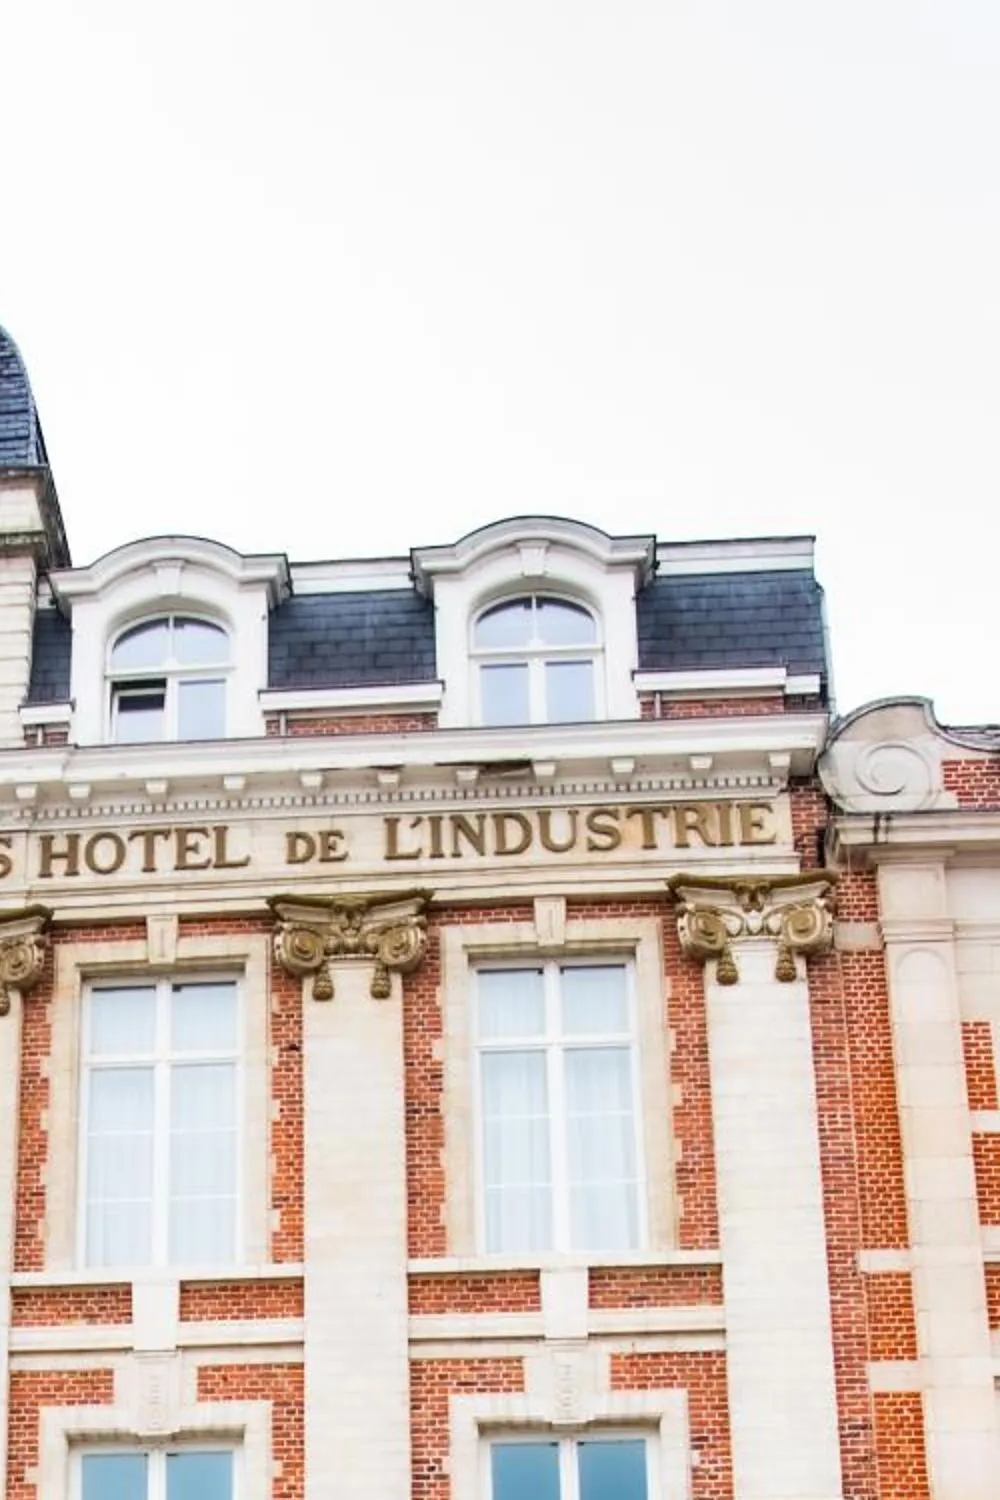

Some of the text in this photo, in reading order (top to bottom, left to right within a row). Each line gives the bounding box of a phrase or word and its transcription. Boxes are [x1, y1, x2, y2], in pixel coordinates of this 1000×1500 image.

[37, 825, 250, 879] HOTEL
[285, 829, 348, 864] DE
[383, 802, 777, 861] L'INDUSTRIE
